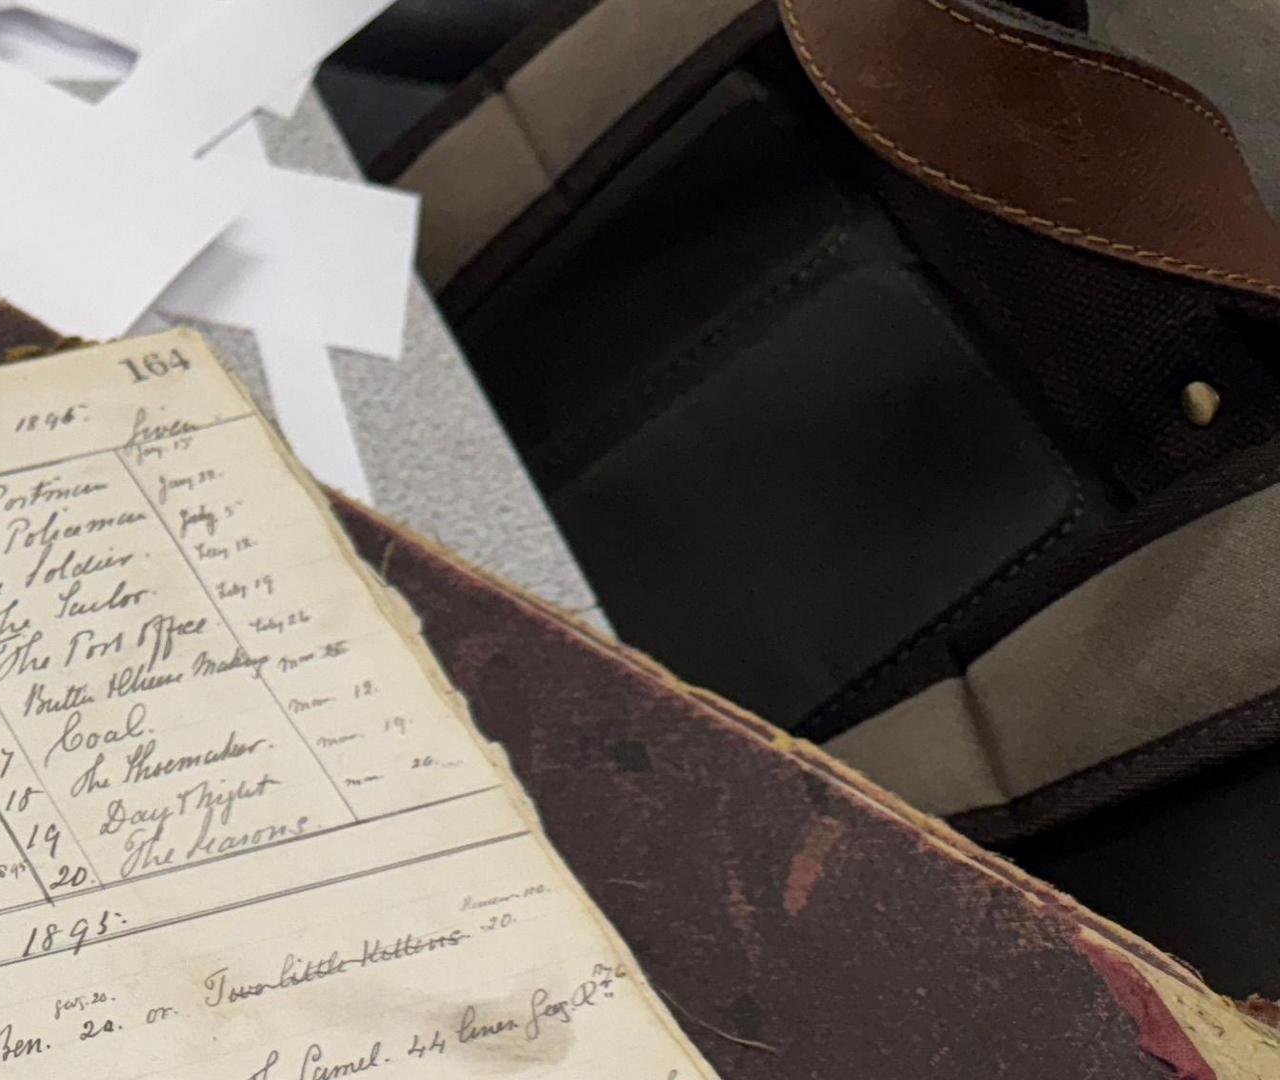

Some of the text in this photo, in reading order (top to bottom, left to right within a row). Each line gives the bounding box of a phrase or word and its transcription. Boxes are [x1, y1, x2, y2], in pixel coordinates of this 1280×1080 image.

[118, 346, 192, 383] 164
[5, 788, 42, 813] 18
[25, 823, 63, 859] 19
[406, 1033, 447, 1059] 44
